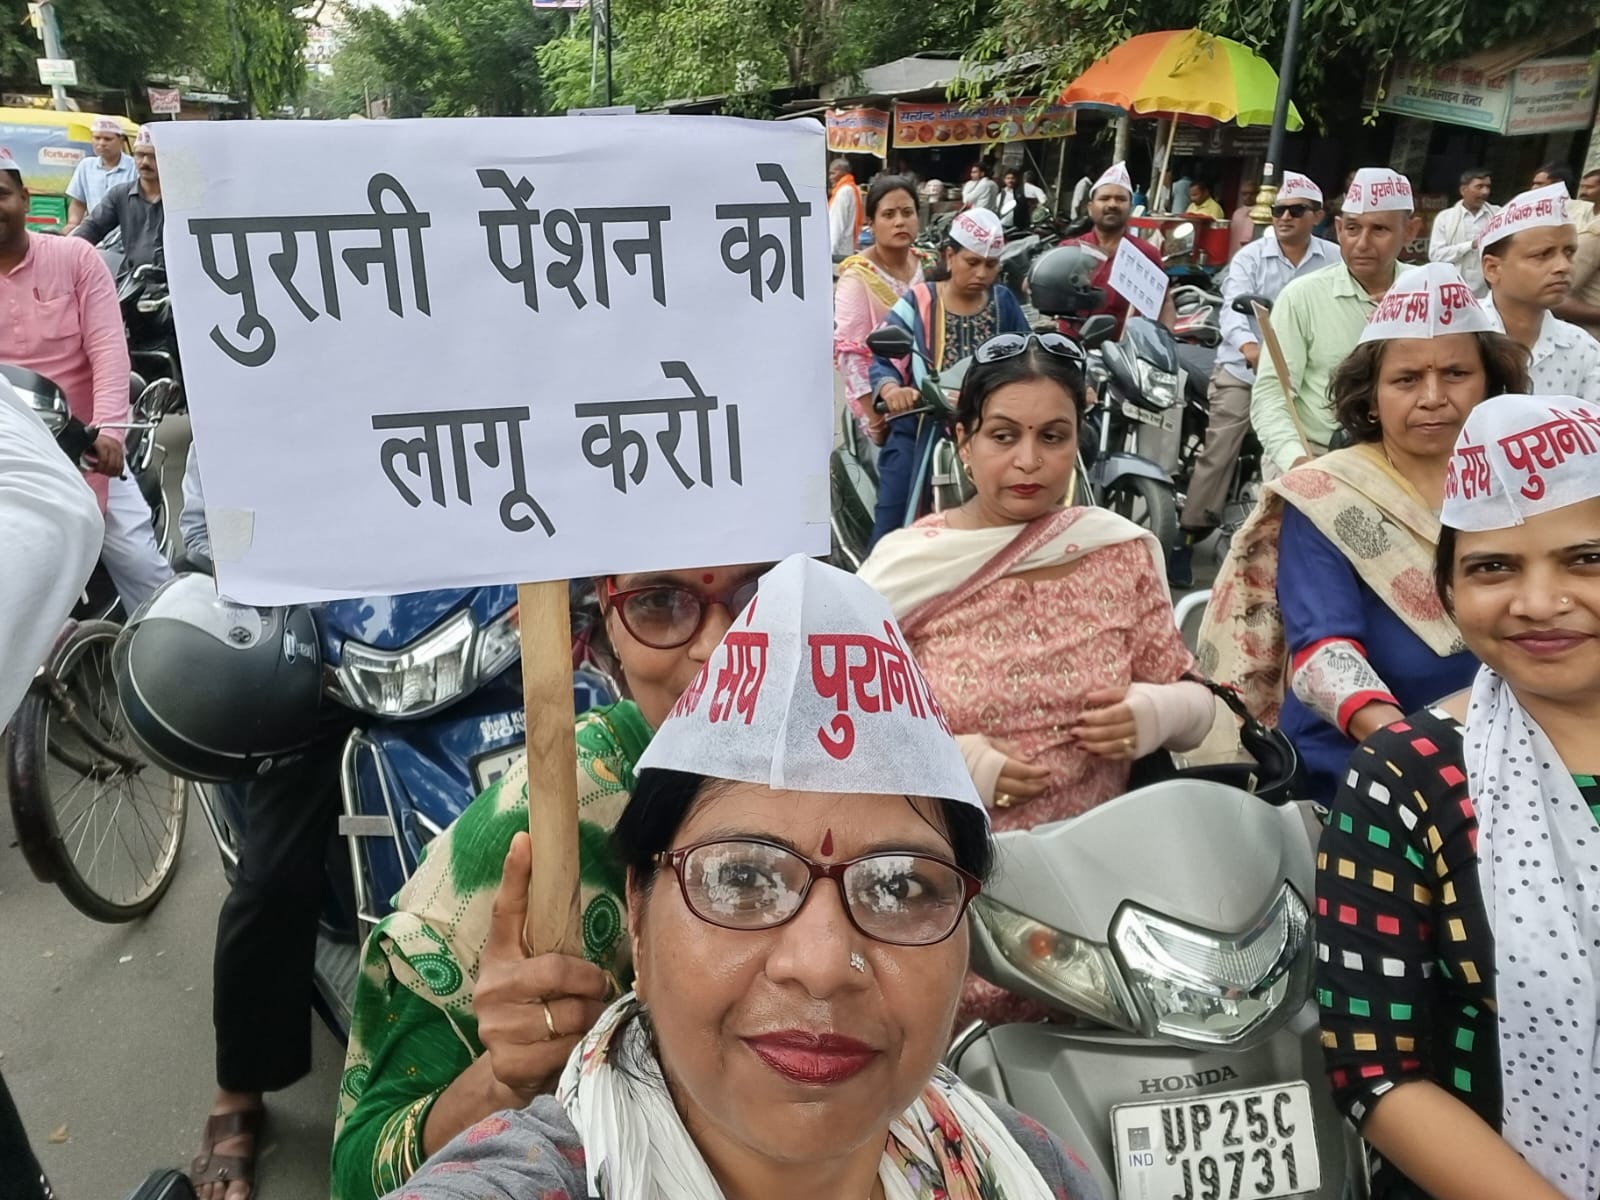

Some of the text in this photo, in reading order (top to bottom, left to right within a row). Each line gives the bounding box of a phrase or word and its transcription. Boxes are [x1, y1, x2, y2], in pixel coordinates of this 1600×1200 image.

[188, 163, 811, 367] पुरानी पेंशन को
[372, 361, 743, 537] लागू करो।
[1497, 408, 1598, 501] पुरानी
[808, 620, 927, 760] पुरानी
[1139, 1066, 1238, 1094] HONDA
[1129, 1153, 1154, 1167] IND
[1173, 1143, 1298, 1200] J9731
